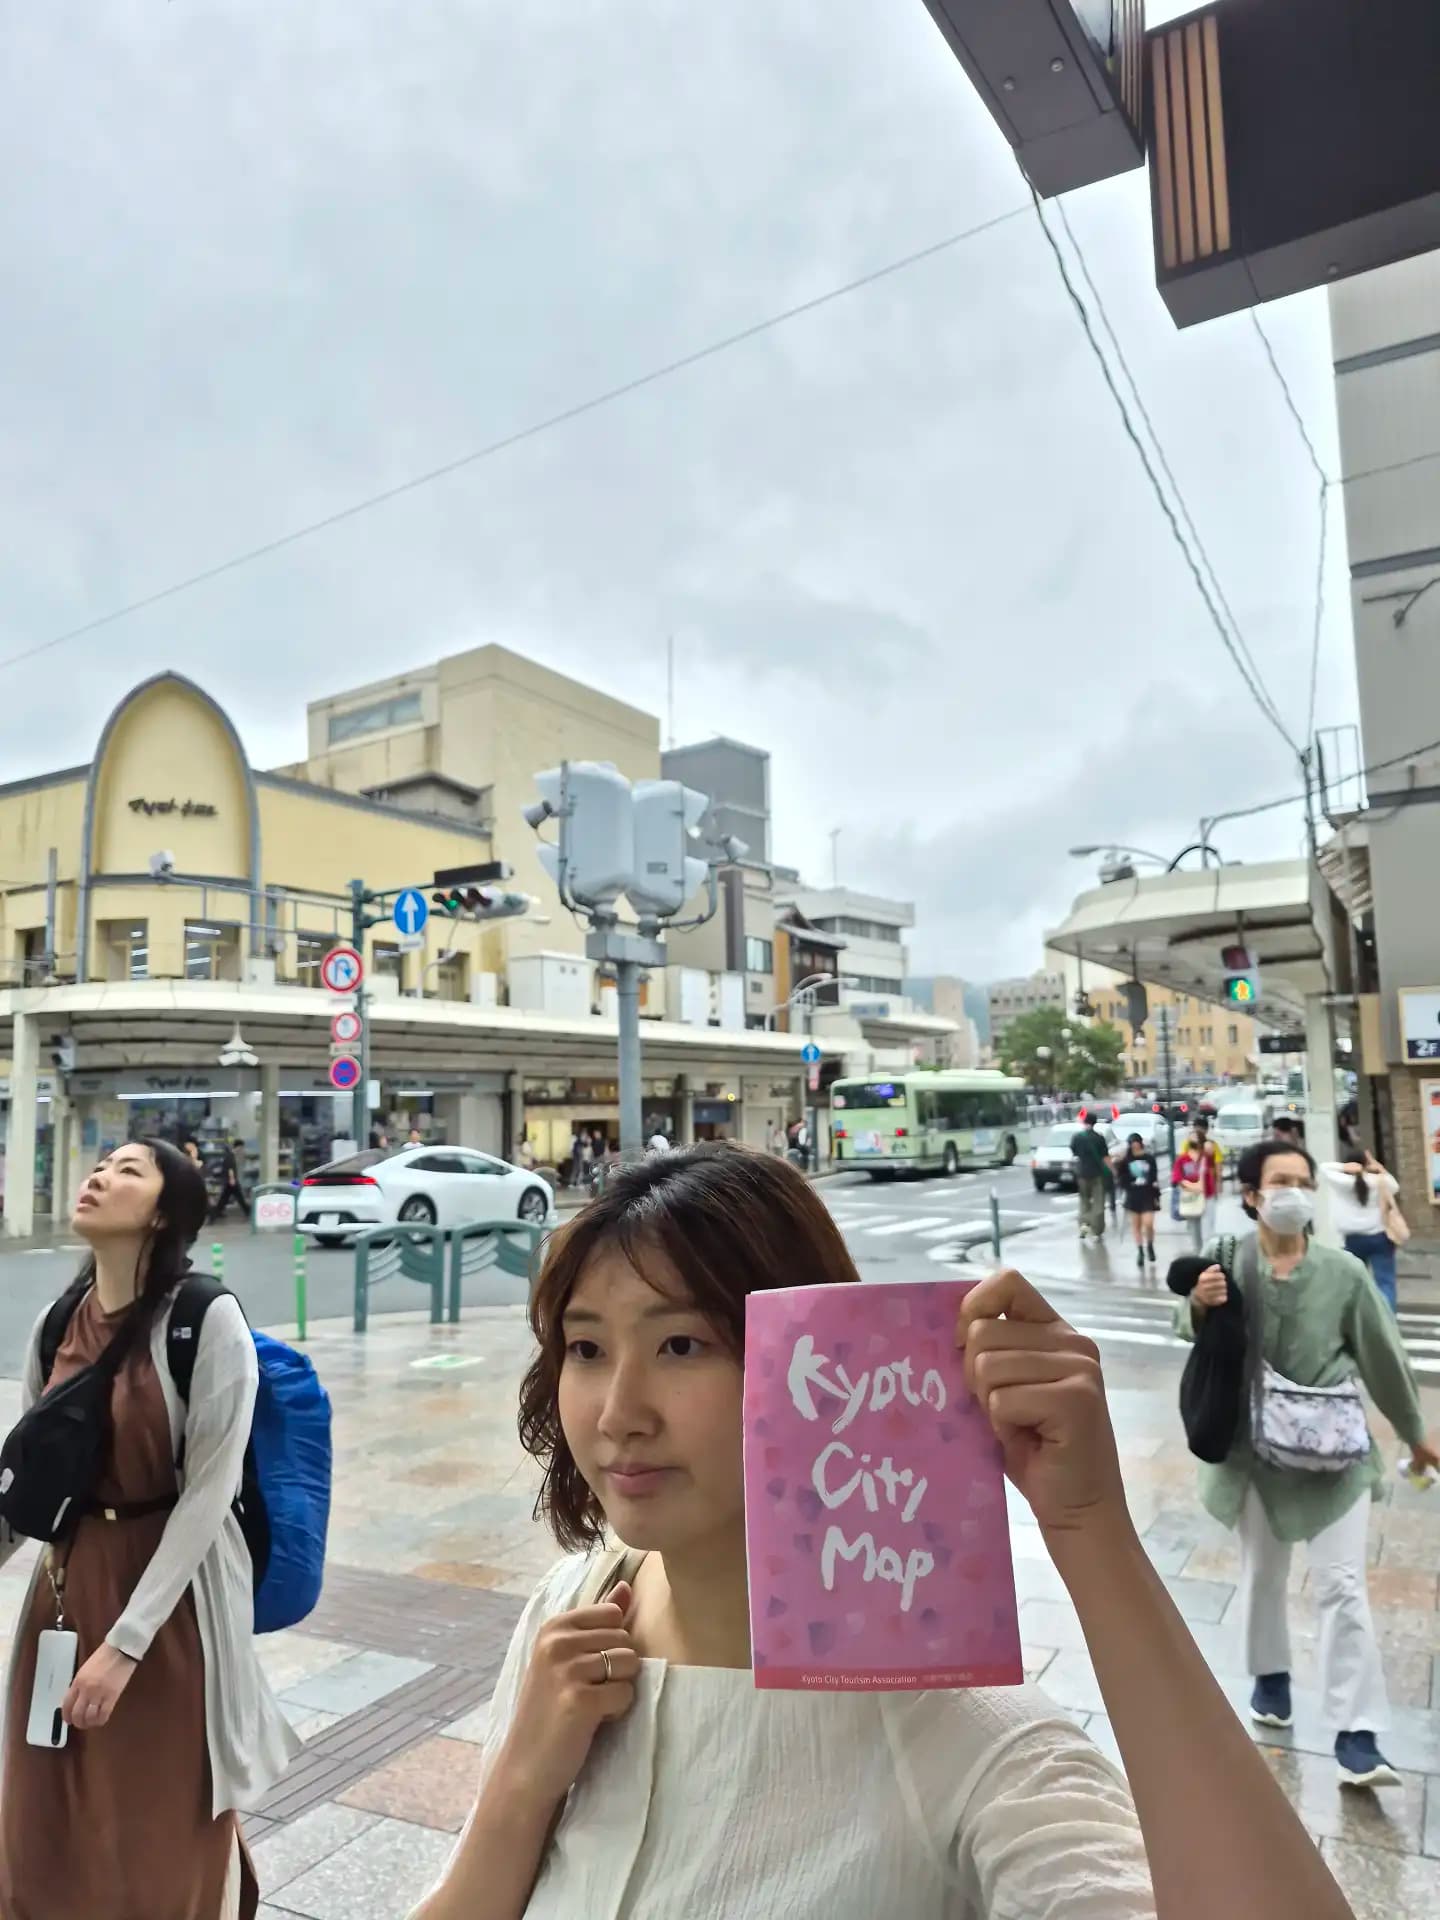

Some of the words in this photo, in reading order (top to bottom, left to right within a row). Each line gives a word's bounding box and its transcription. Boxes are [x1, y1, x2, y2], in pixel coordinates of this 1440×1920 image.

[1416, 1039, 1438, 1057] 2F
[787, 1334, 946, 1433] Kyoto
[811, 1441, 928, 1523] City
[820, 1525, 934, 1612] Map
[800, 1674, 823, 1685] Kyoto
[824, 1674, 839, 1686] City
[840, 1674, 871, 1685] Tourism
[872, 1674, 917, 1685] Association
